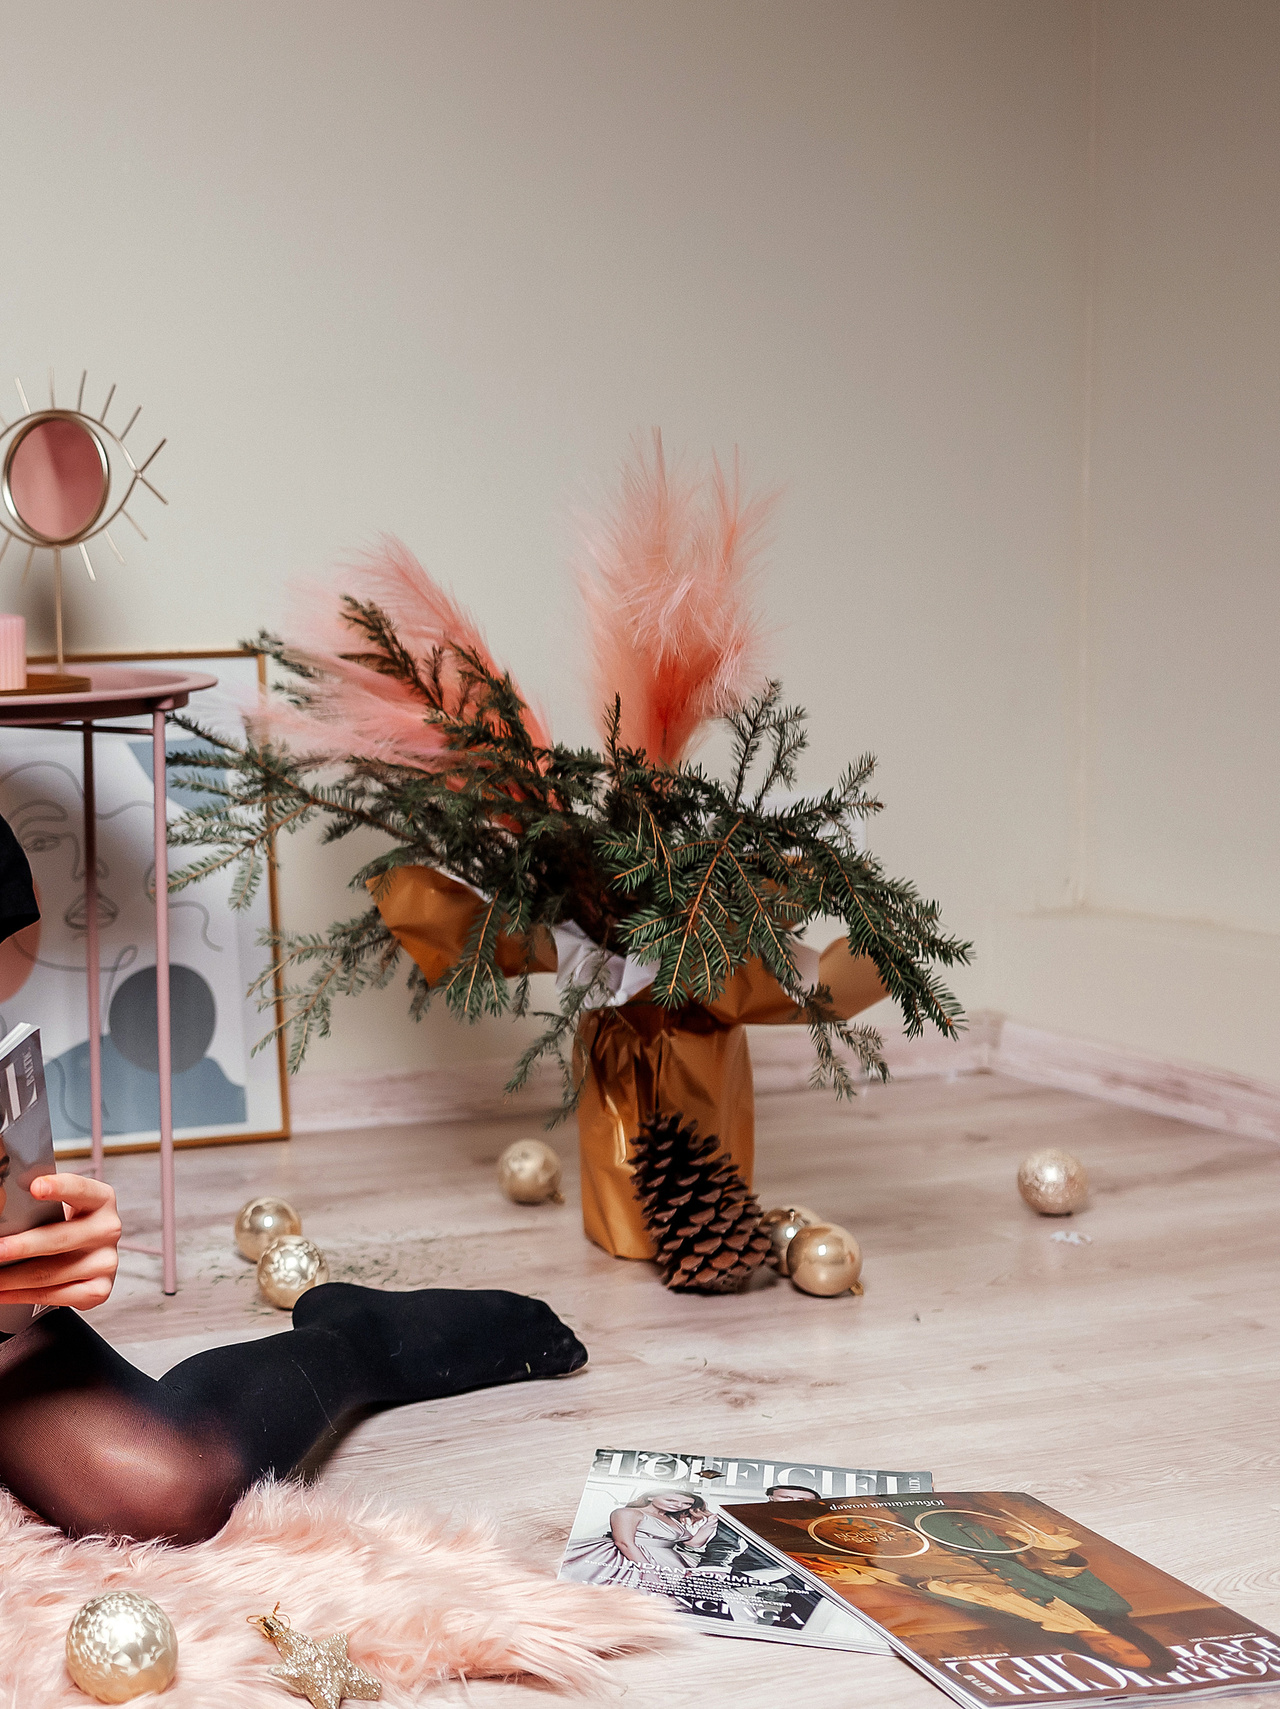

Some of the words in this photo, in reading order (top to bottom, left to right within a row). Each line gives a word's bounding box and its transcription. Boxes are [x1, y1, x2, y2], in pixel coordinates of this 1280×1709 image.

[829, 1501, 868, 1512] номер
[623, 1557, 687, 1575] INDIAN
[690, 1569, 772, 1586] SUMMER
